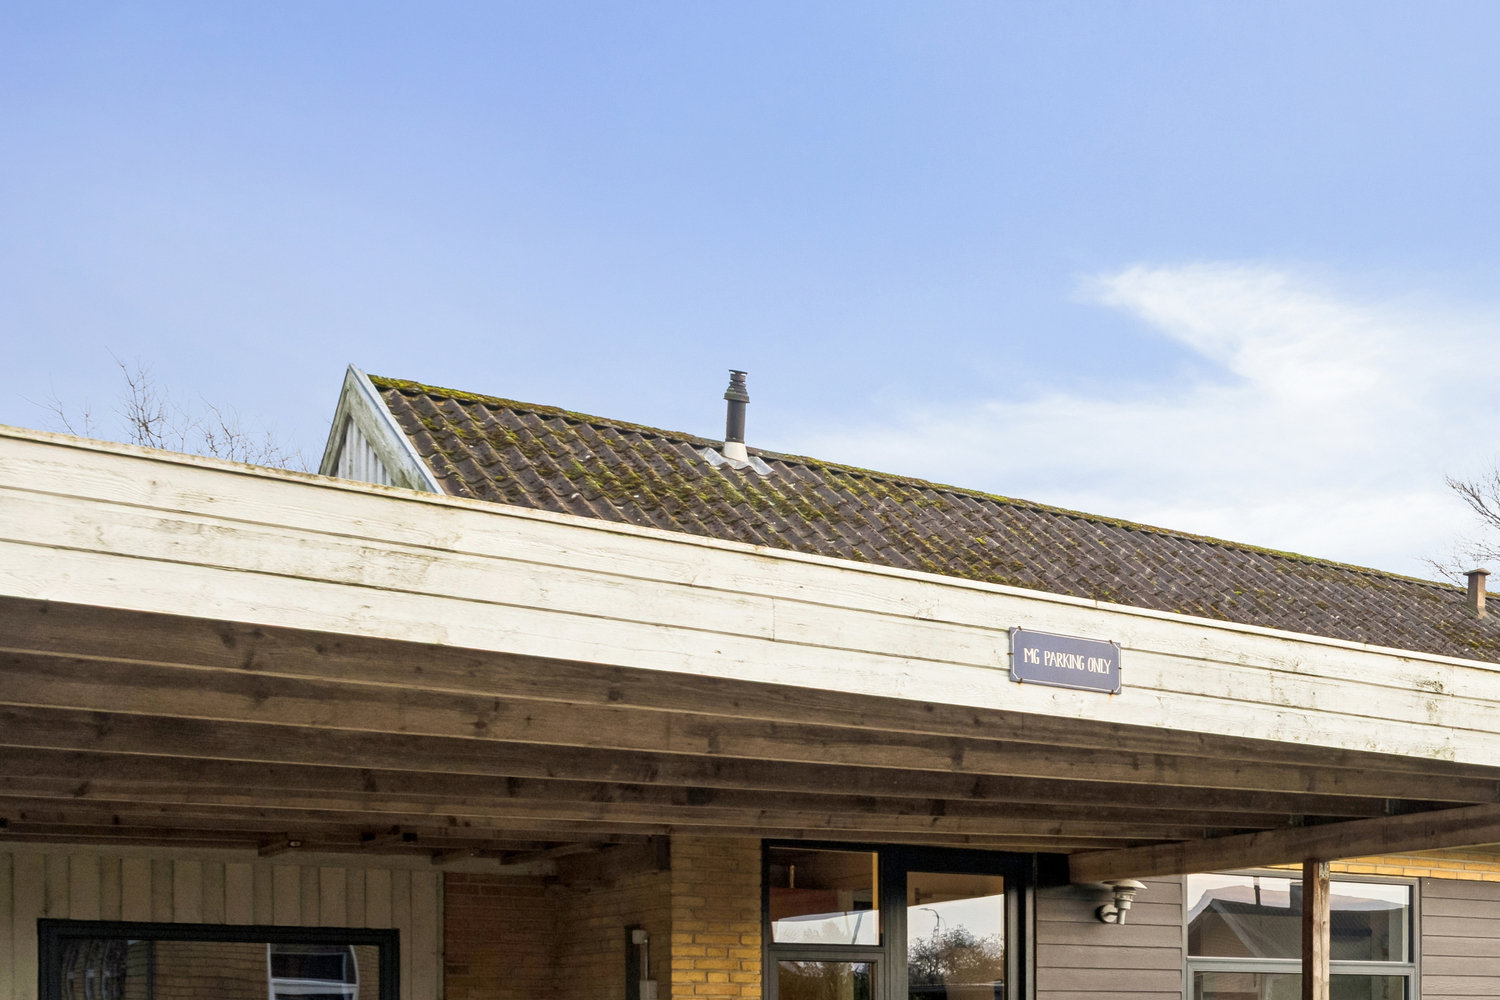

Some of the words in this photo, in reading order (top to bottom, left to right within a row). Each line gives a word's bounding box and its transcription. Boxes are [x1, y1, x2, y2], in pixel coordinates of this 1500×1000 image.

[1023, 647, 1040, 665] MG
[1044, 650, 1085, 671] PARKING
[1087, 656, 1112, 675] ONLY
